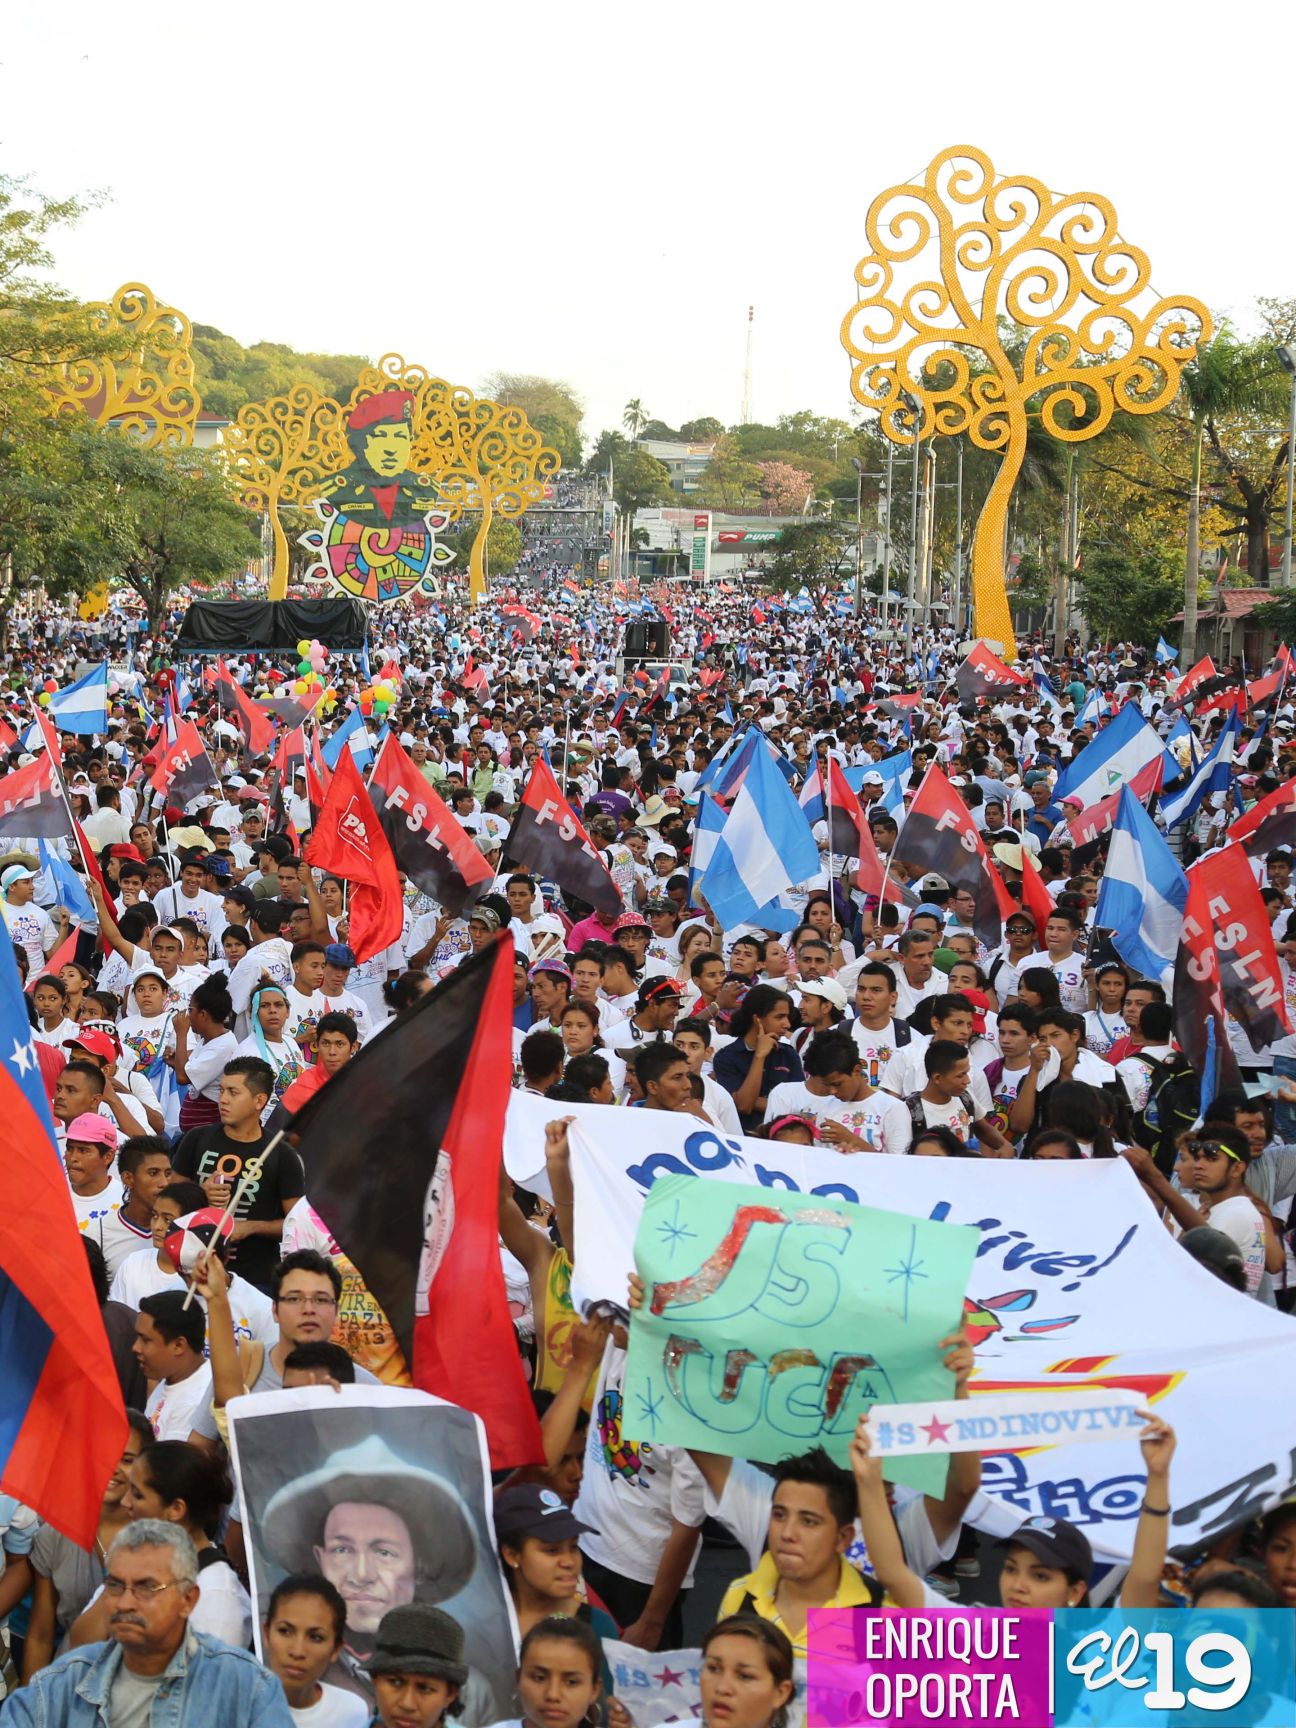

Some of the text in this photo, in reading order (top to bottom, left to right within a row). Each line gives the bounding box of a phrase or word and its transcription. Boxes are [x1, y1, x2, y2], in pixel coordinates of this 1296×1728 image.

[384, 785, 454, 862] FSL
[1208, 895, 1283, 1010] FSLN
[198, 1150, 264, 1181] FOS
